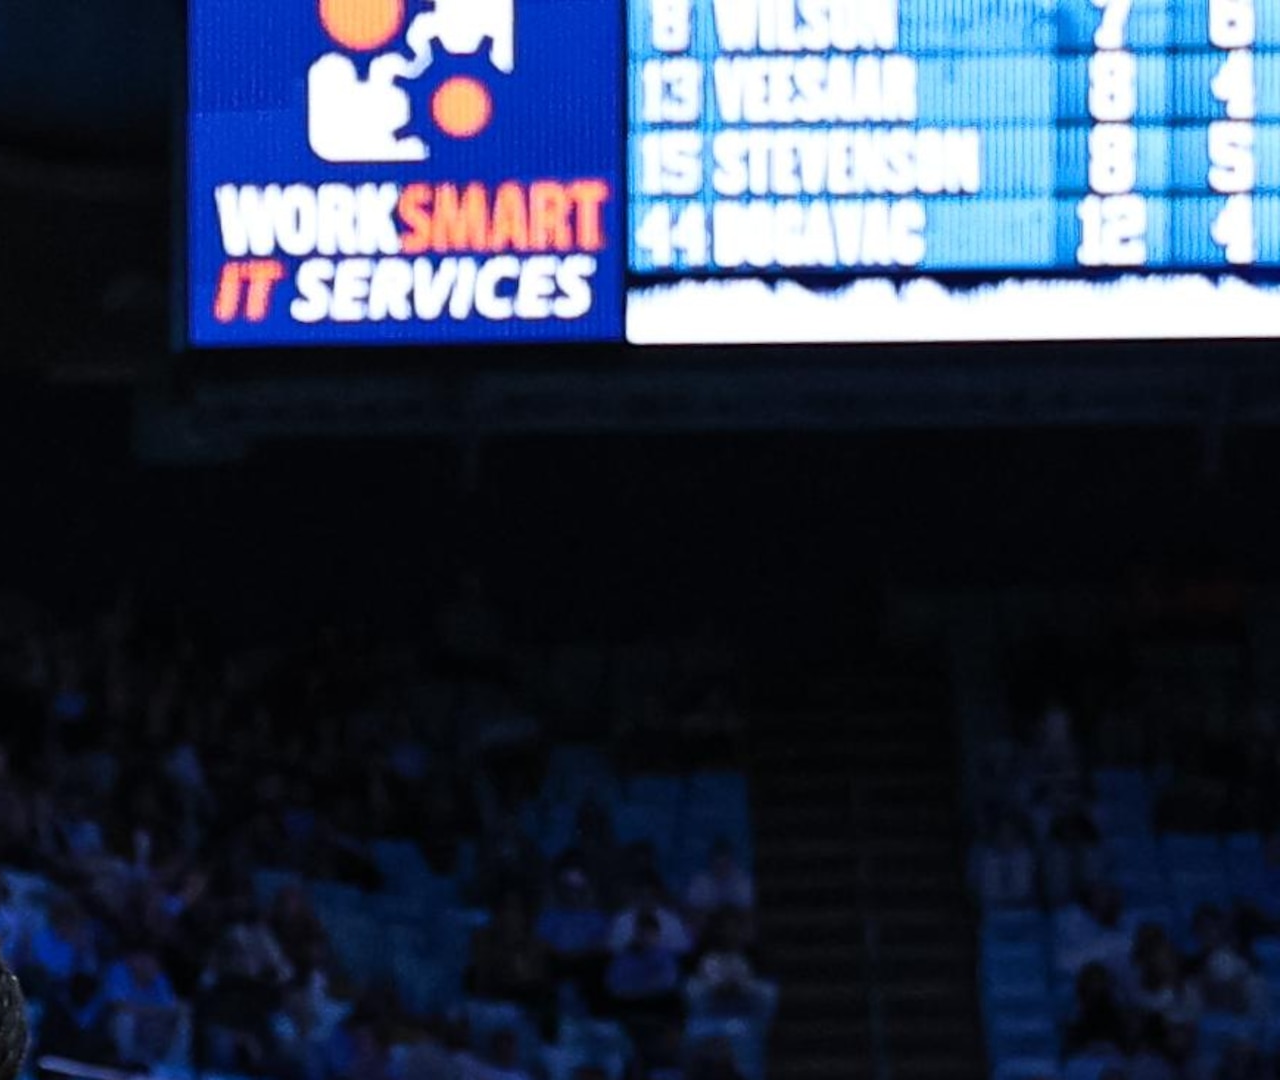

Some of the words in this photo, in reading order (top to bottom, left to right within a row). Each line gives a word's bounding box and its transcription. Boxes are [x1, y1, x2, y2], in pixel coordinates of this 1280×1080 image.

[643, 56, 700, 123] 13
[1089, 51, 1134, 121] 8
[1210, 50, 1253, 120] 4
[642, 130, 702, 196] 15
[713, 127, 980, 196] STEVENSON
[1089, 122, 1135, 193] 8
[1208, 120, 1254, 194] 5
[214, 178, 608, 257] WORKSMART
[634, 199, 706, 268] 44
[1077, 194, 1147, 266] 12
[1210, 193, 1253, 265] 4
[214, 258, 284, 323] IT
[290, 252, 597, 323] SERVICES
